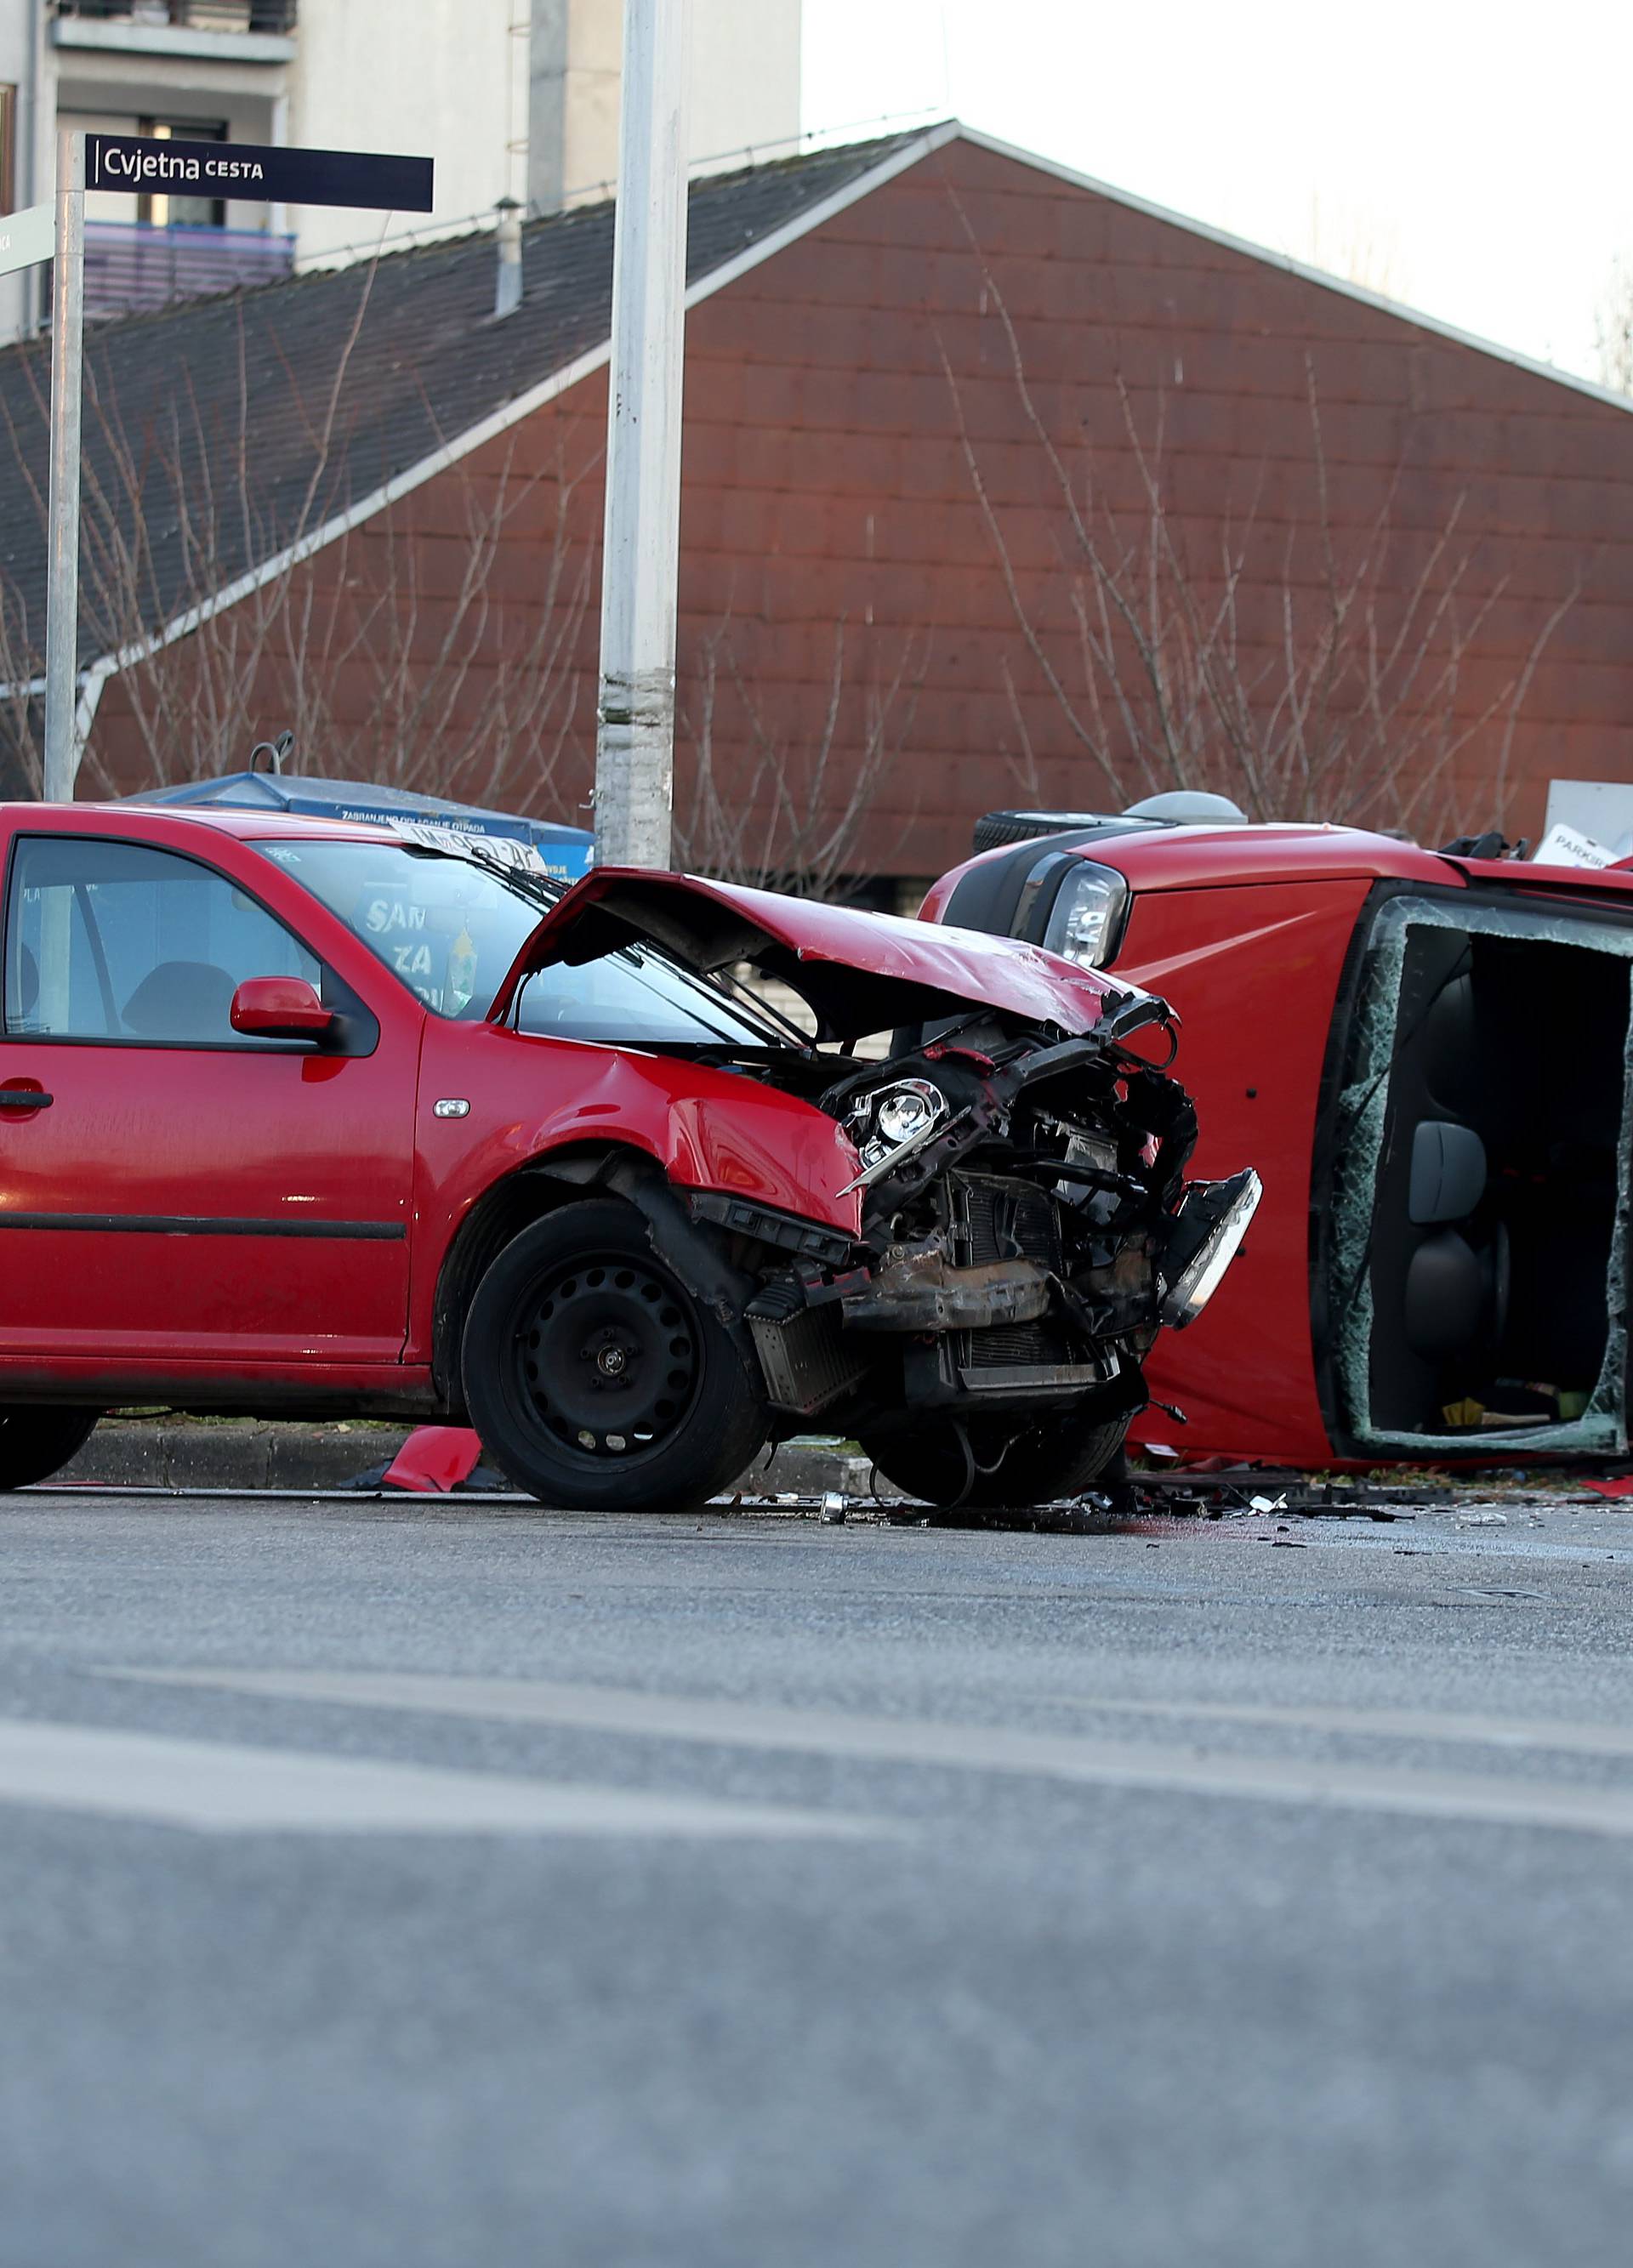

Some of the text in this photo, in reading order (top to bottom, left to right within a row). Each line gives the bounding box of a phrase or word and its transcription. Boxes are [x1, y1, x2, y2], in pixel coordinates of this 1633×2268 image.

[104, 147, 264, 183] Cvjetna CESTA
[452, 821, 485, 834] OTPADA
[394, 945, 431, 975] ZA
